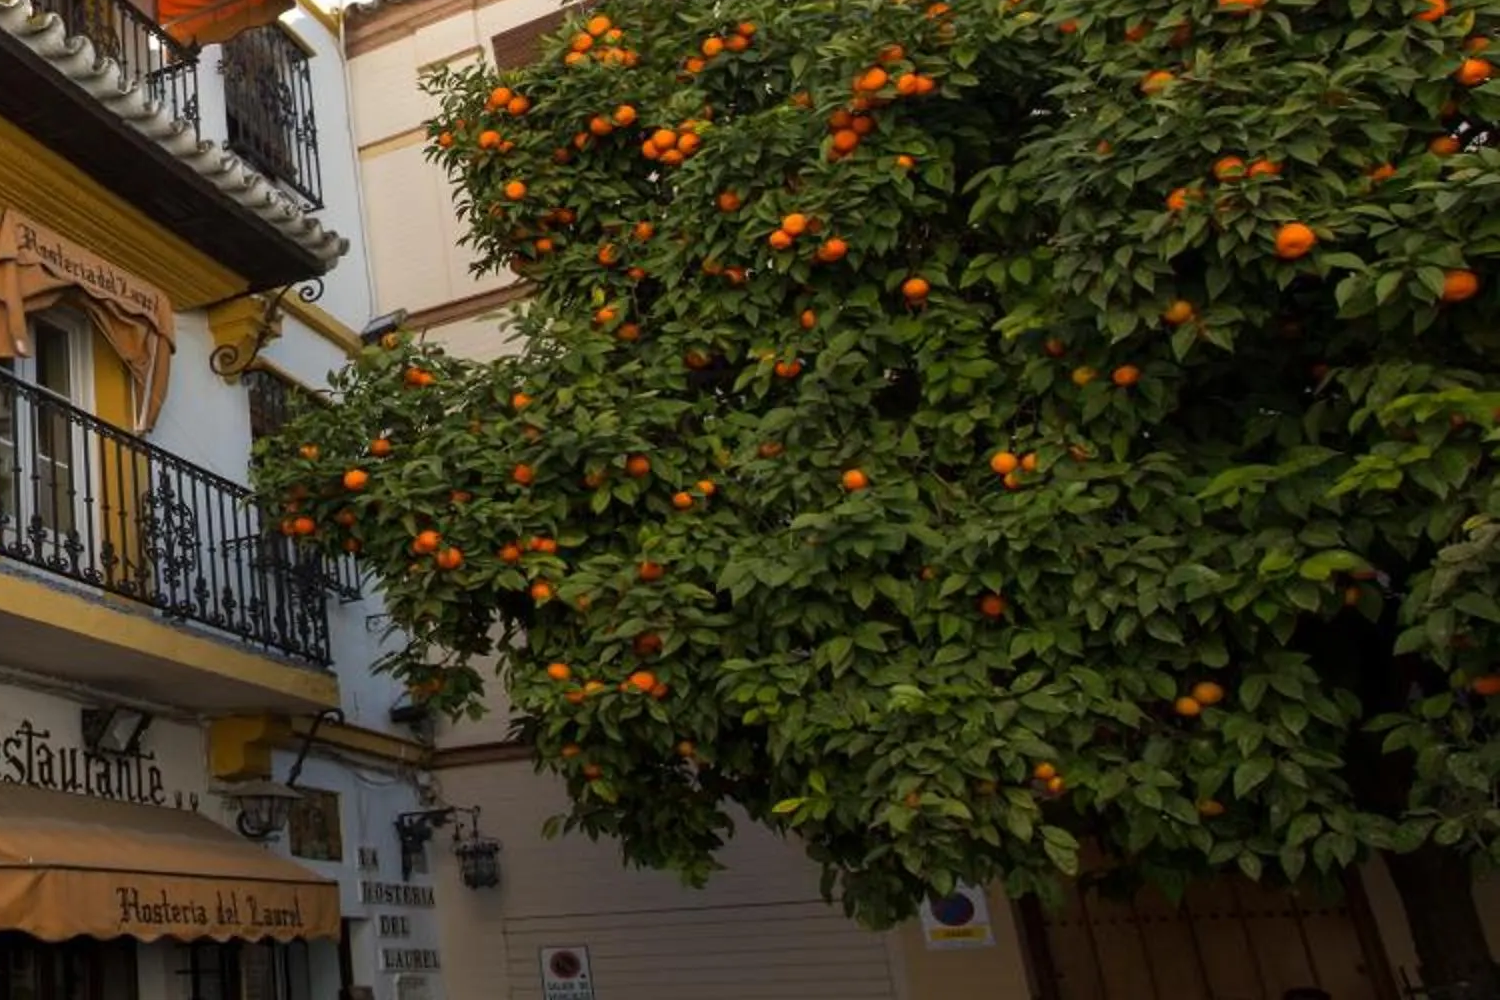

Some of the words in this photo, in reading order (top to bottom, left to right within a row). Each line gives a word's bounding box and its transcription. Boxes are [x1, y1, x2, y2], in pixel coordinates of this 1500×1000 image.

[116, 887, 209, 926] Hosteria
[216, 890, 241, 926] del
[246, 893, 304, 928] Laurel
[380, 915, 410, 938] DEL
[383, 949, 440, 972] LAUREL
